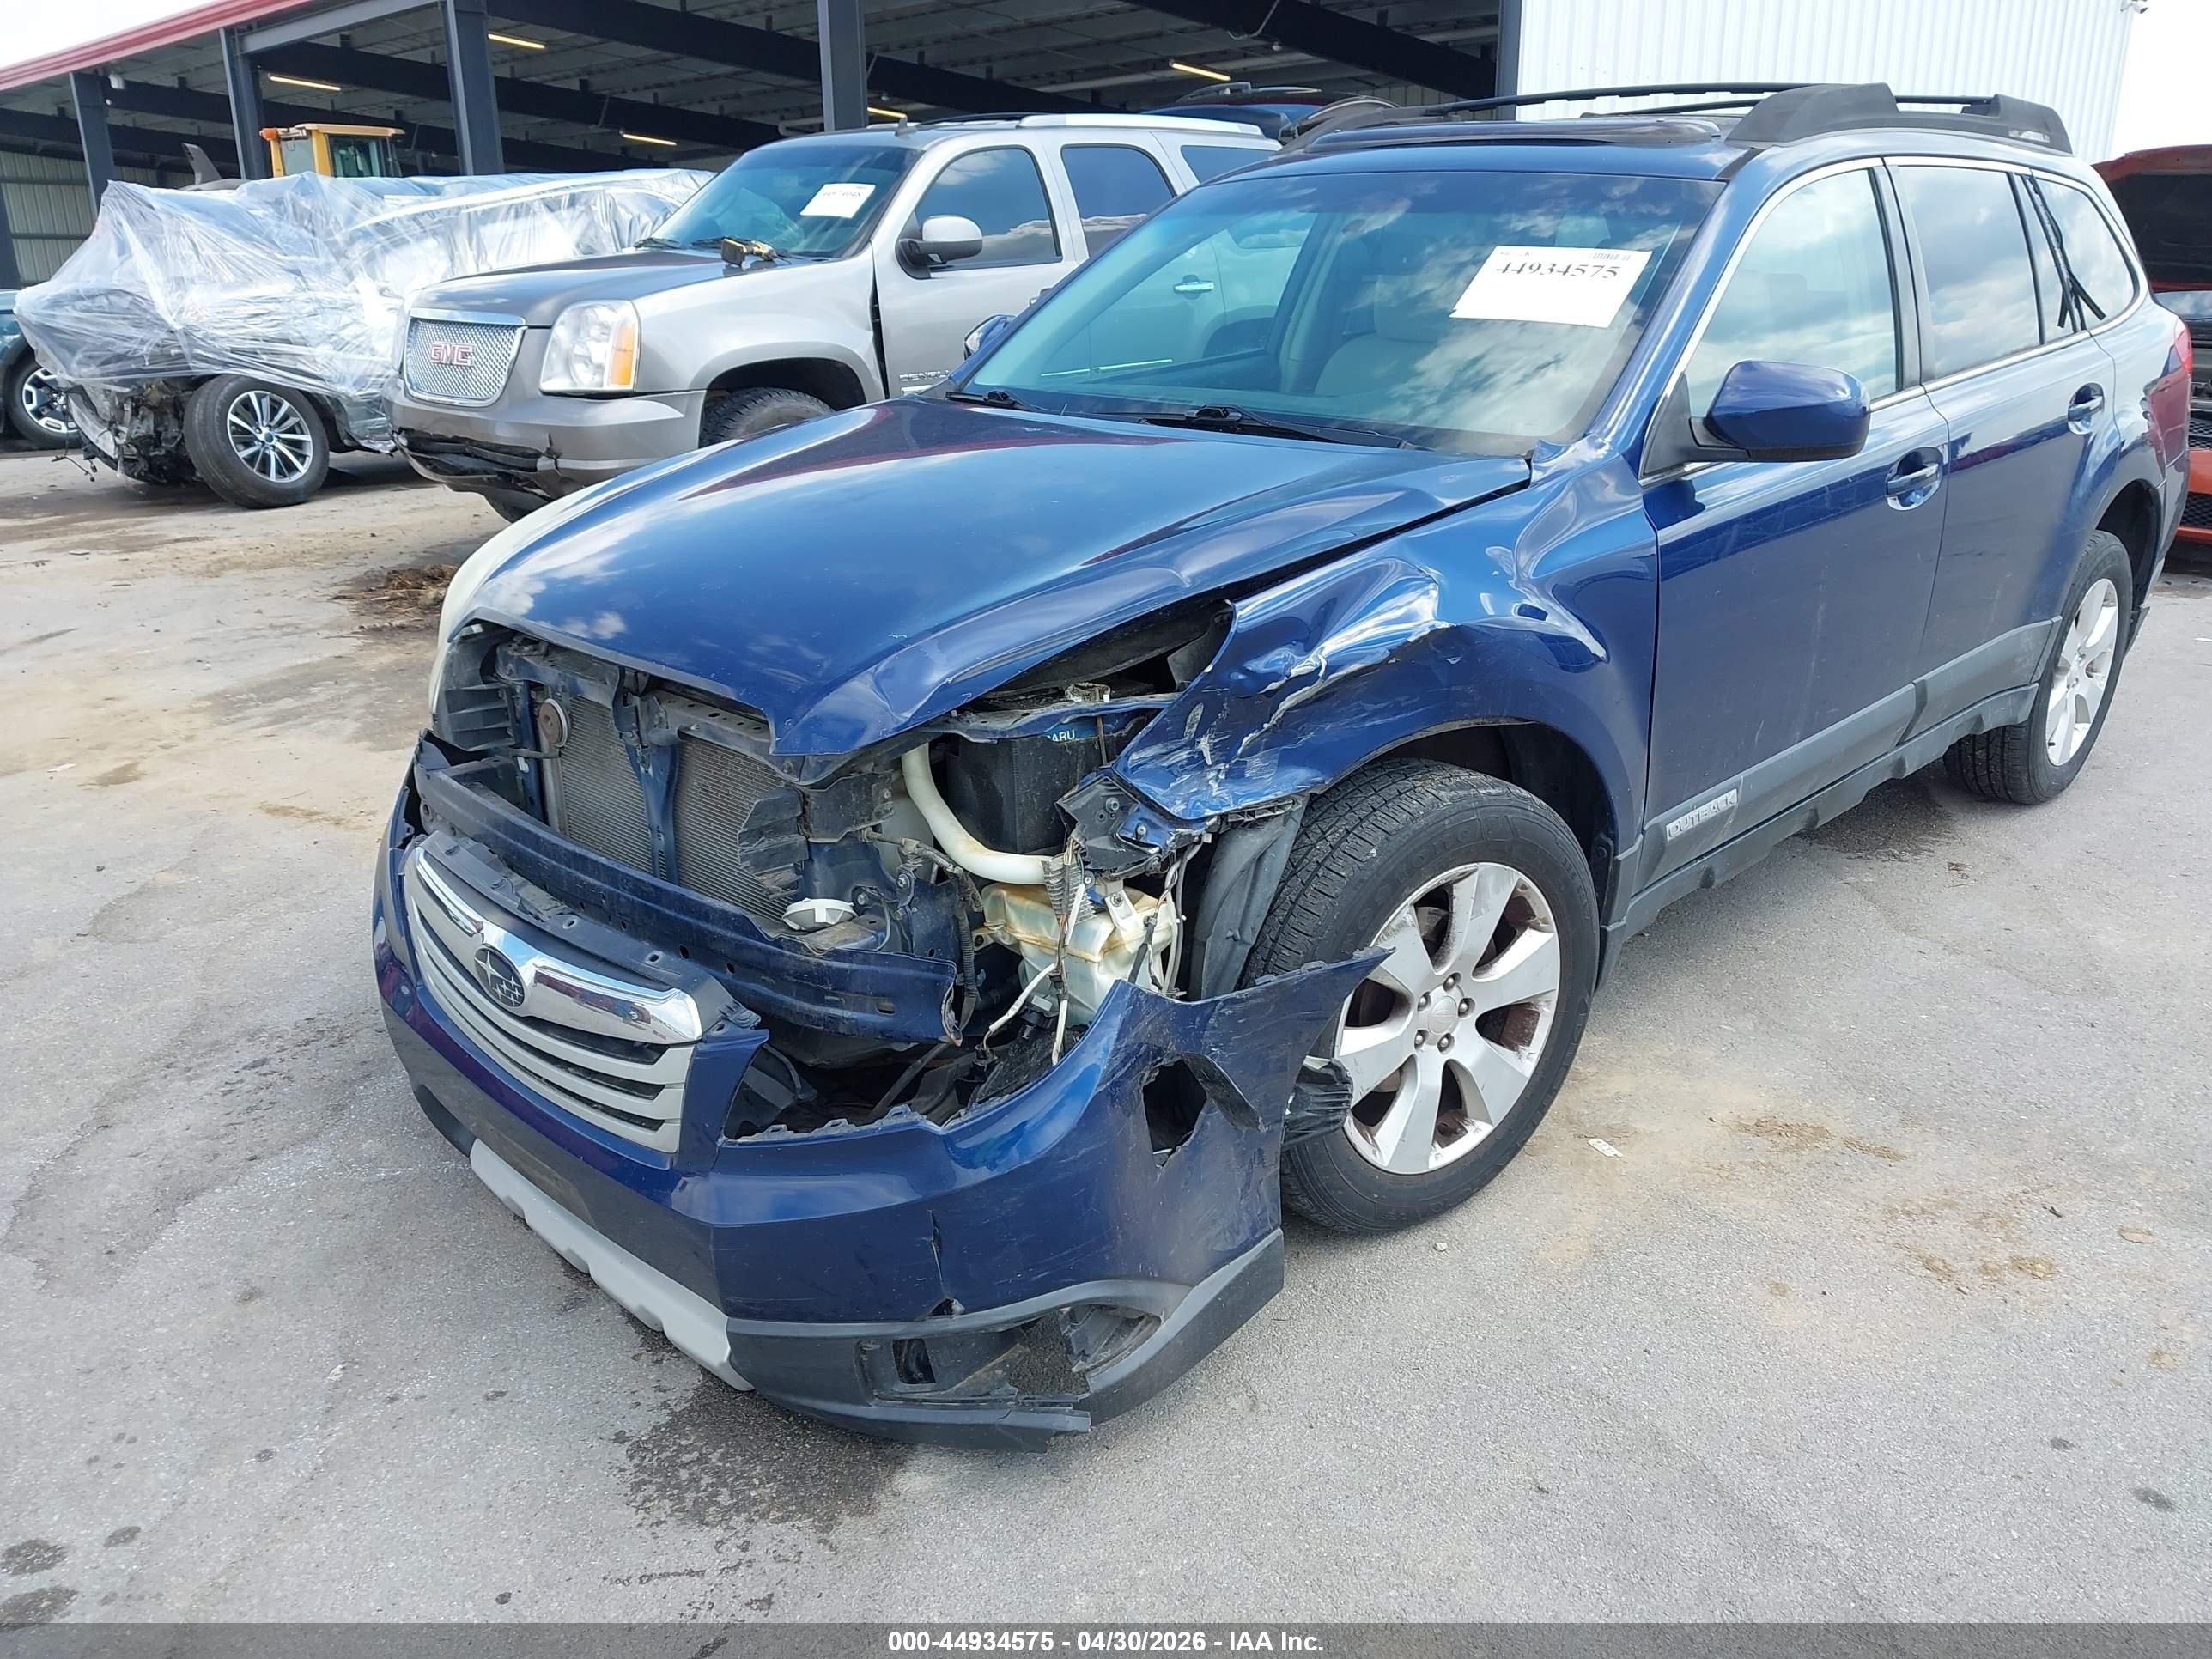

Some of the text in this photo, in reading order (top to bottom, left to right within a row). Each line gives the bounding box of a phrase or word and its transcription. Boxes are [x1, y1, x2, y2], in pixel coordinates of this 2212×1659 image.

[1496, 261, 1621, 279] 44934575
[430, 341, 475, 367] GMC
[1047, 729, 1076, 742] ARU
[1668, 789, 1738, 839] OUTBACK
